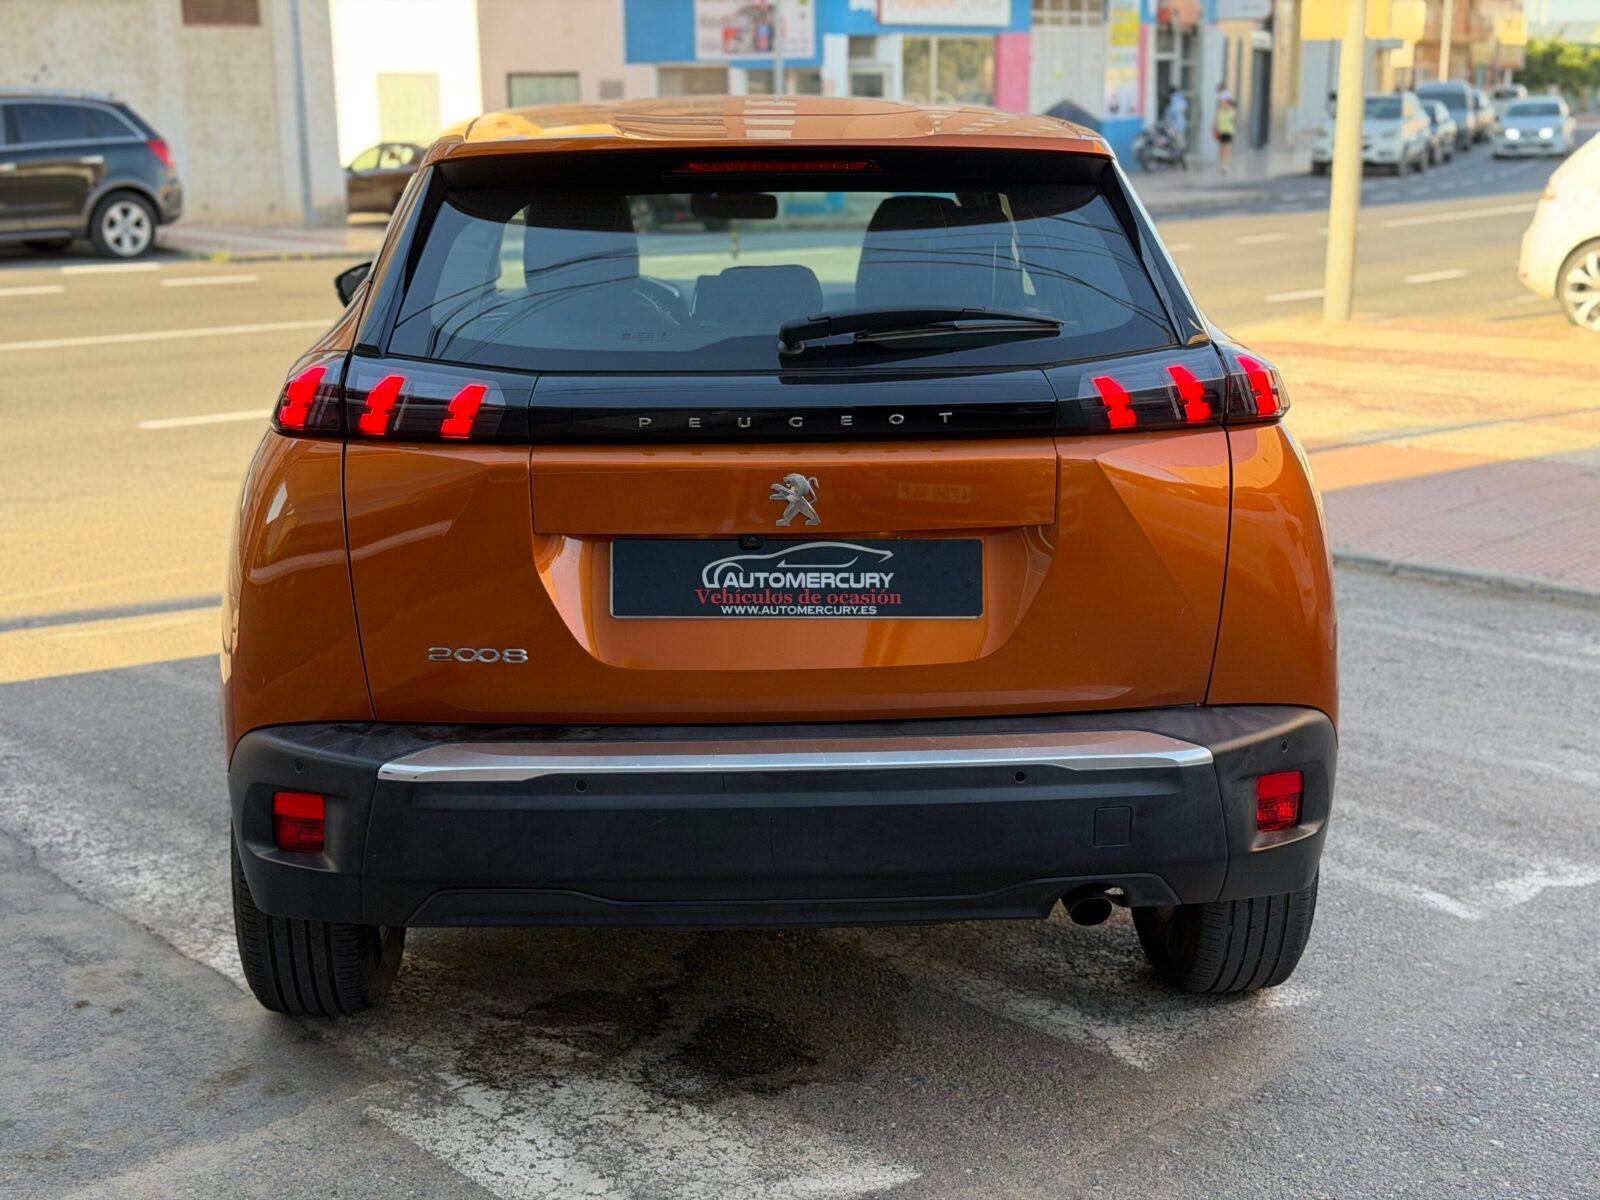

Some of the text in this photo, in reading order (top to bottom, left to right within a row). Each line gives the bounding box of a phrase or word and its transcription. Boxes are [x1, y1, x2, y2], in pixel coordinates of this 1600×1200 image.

[638, 411, 953, 428] PEUGEOT
[722, 571, 895, 589] AUTOMERCURY
[695, 588, 903, 605] Vehículos de ocasión
[720, 605, 877, 616] WWW.AUTOMERCURY.ES
[427, 646, 529, 663] 2008
